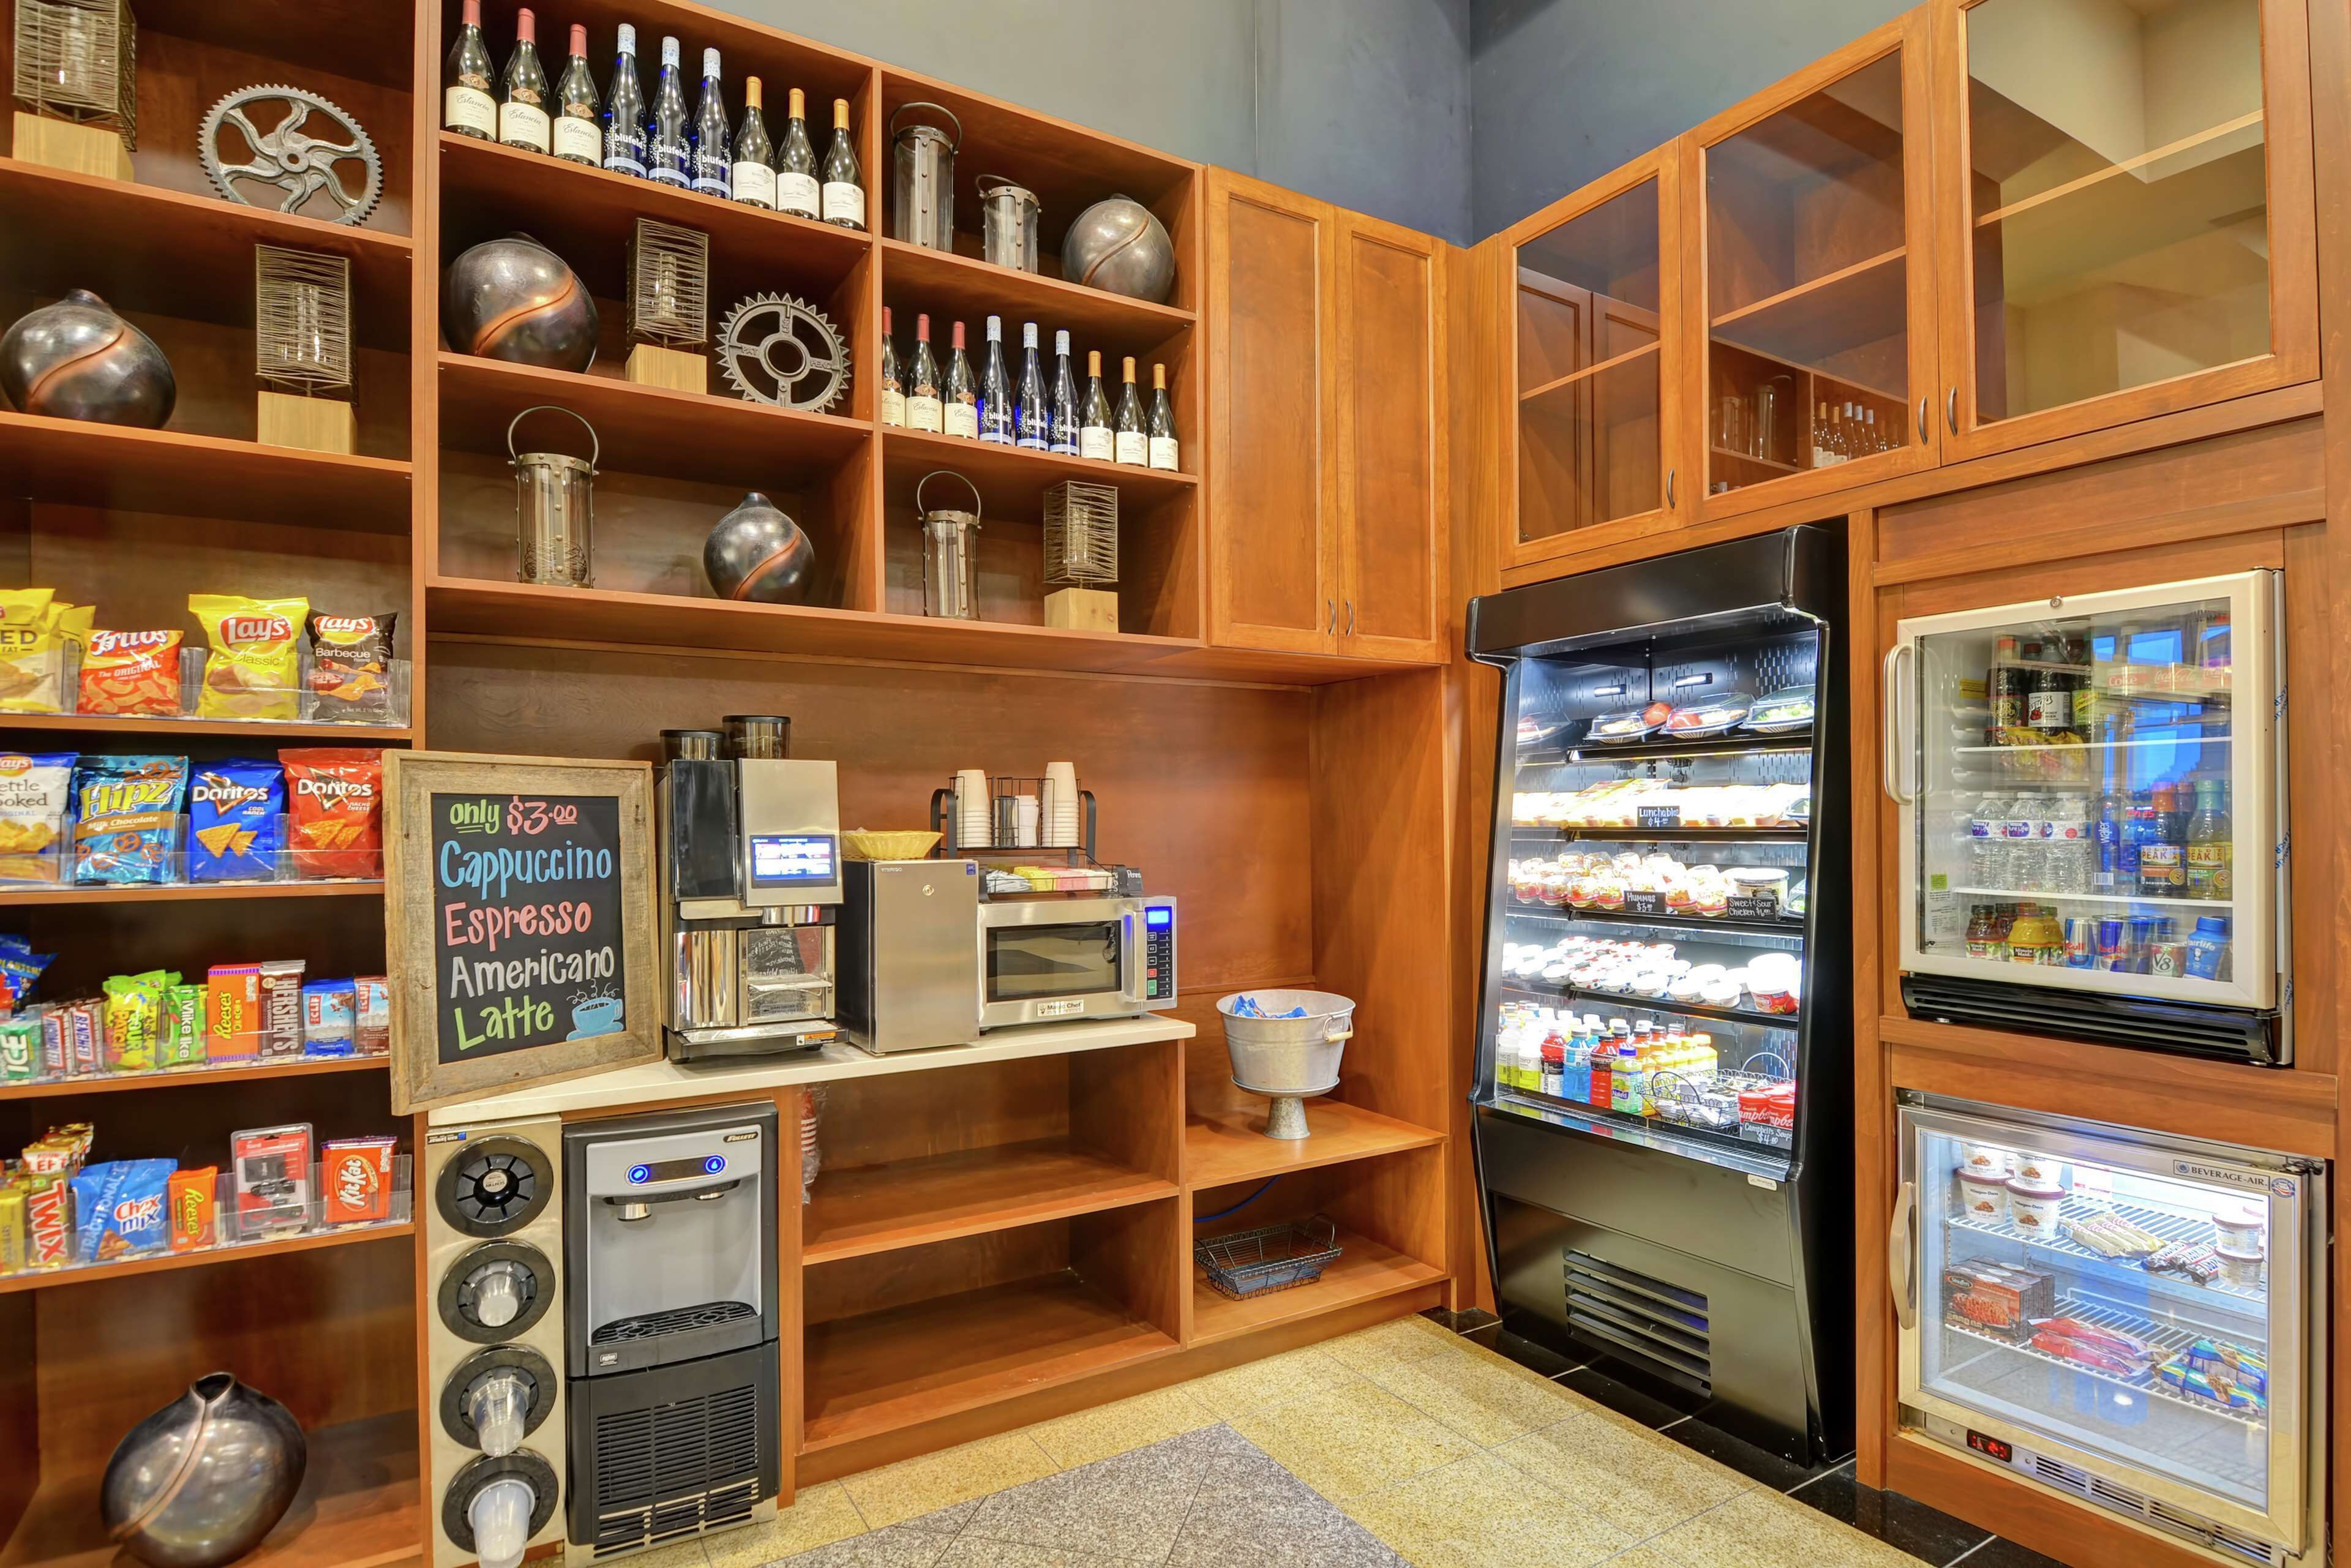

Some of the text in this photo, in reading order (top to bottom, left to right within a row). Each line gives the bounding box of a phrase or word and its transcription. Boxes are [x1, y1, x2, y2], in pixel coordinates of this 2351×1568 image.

[614, 133, 643, 149] blufeld
[658, 143, 687, 159] blufeld
[701, 154, 730, 170] blufeld
[227, 617, 287, 644] Lay's
[320, 617, 370, 633] Lay's
[315, 648, 371, 659] Barbecue
[2109, 675, 2137, 687] Coke
[192, 786, 269, 802] Doritos
[298, 778, 373, 797] Doritos
[1639, 806, 1679, 817] Lunchables
[110, 816, 159, 827] Chocolate
[2098, 820, 2110, 844] water
[440, 840, 612, 901] Cappuccino
[1728, 907, 1755, 917] Chicken
[1757, 899, 1773, 907] Sour
[444, 901, 592, 952] Espresso
[2153, 951, 2172, 971] V8
[451, 945, 615, 999] Americano
[180, 998, 195, 1035] Mike
[213, 991, 232, 1040] Reese's
[272, 978, 298, 1051] HERSHEY'S
[454, 994, 555, 1051] Latte
[2191, 1165, 2265, 1187] BEVERAGE-AIR
[29, 1179, 67, 1262] TWIX
